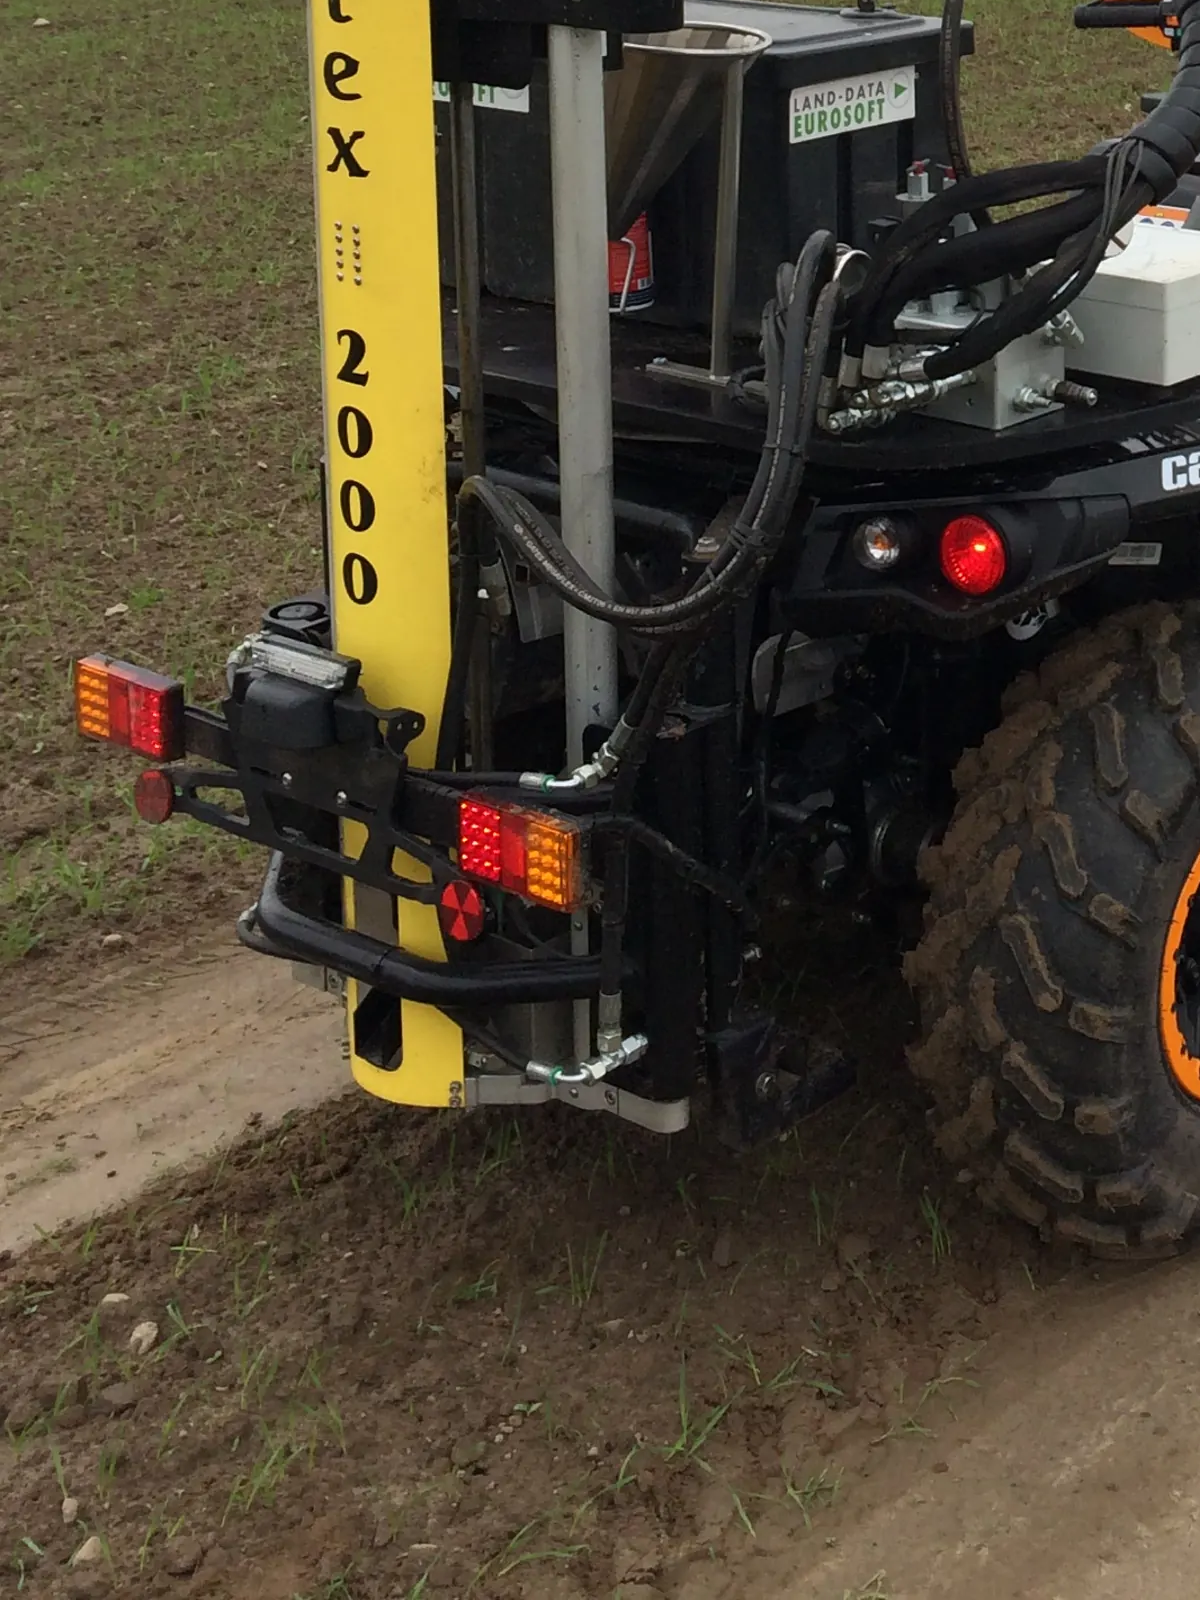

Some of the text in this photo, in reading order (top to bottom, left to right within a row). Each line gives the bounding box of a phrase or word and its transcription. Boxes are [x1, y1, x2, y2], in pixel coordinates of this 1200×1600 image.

[794, 81, 885, 113] LAND-DATA
[793, 98, 885, 138] EUROSOFT
[336, 328, 378, 605] 2000
